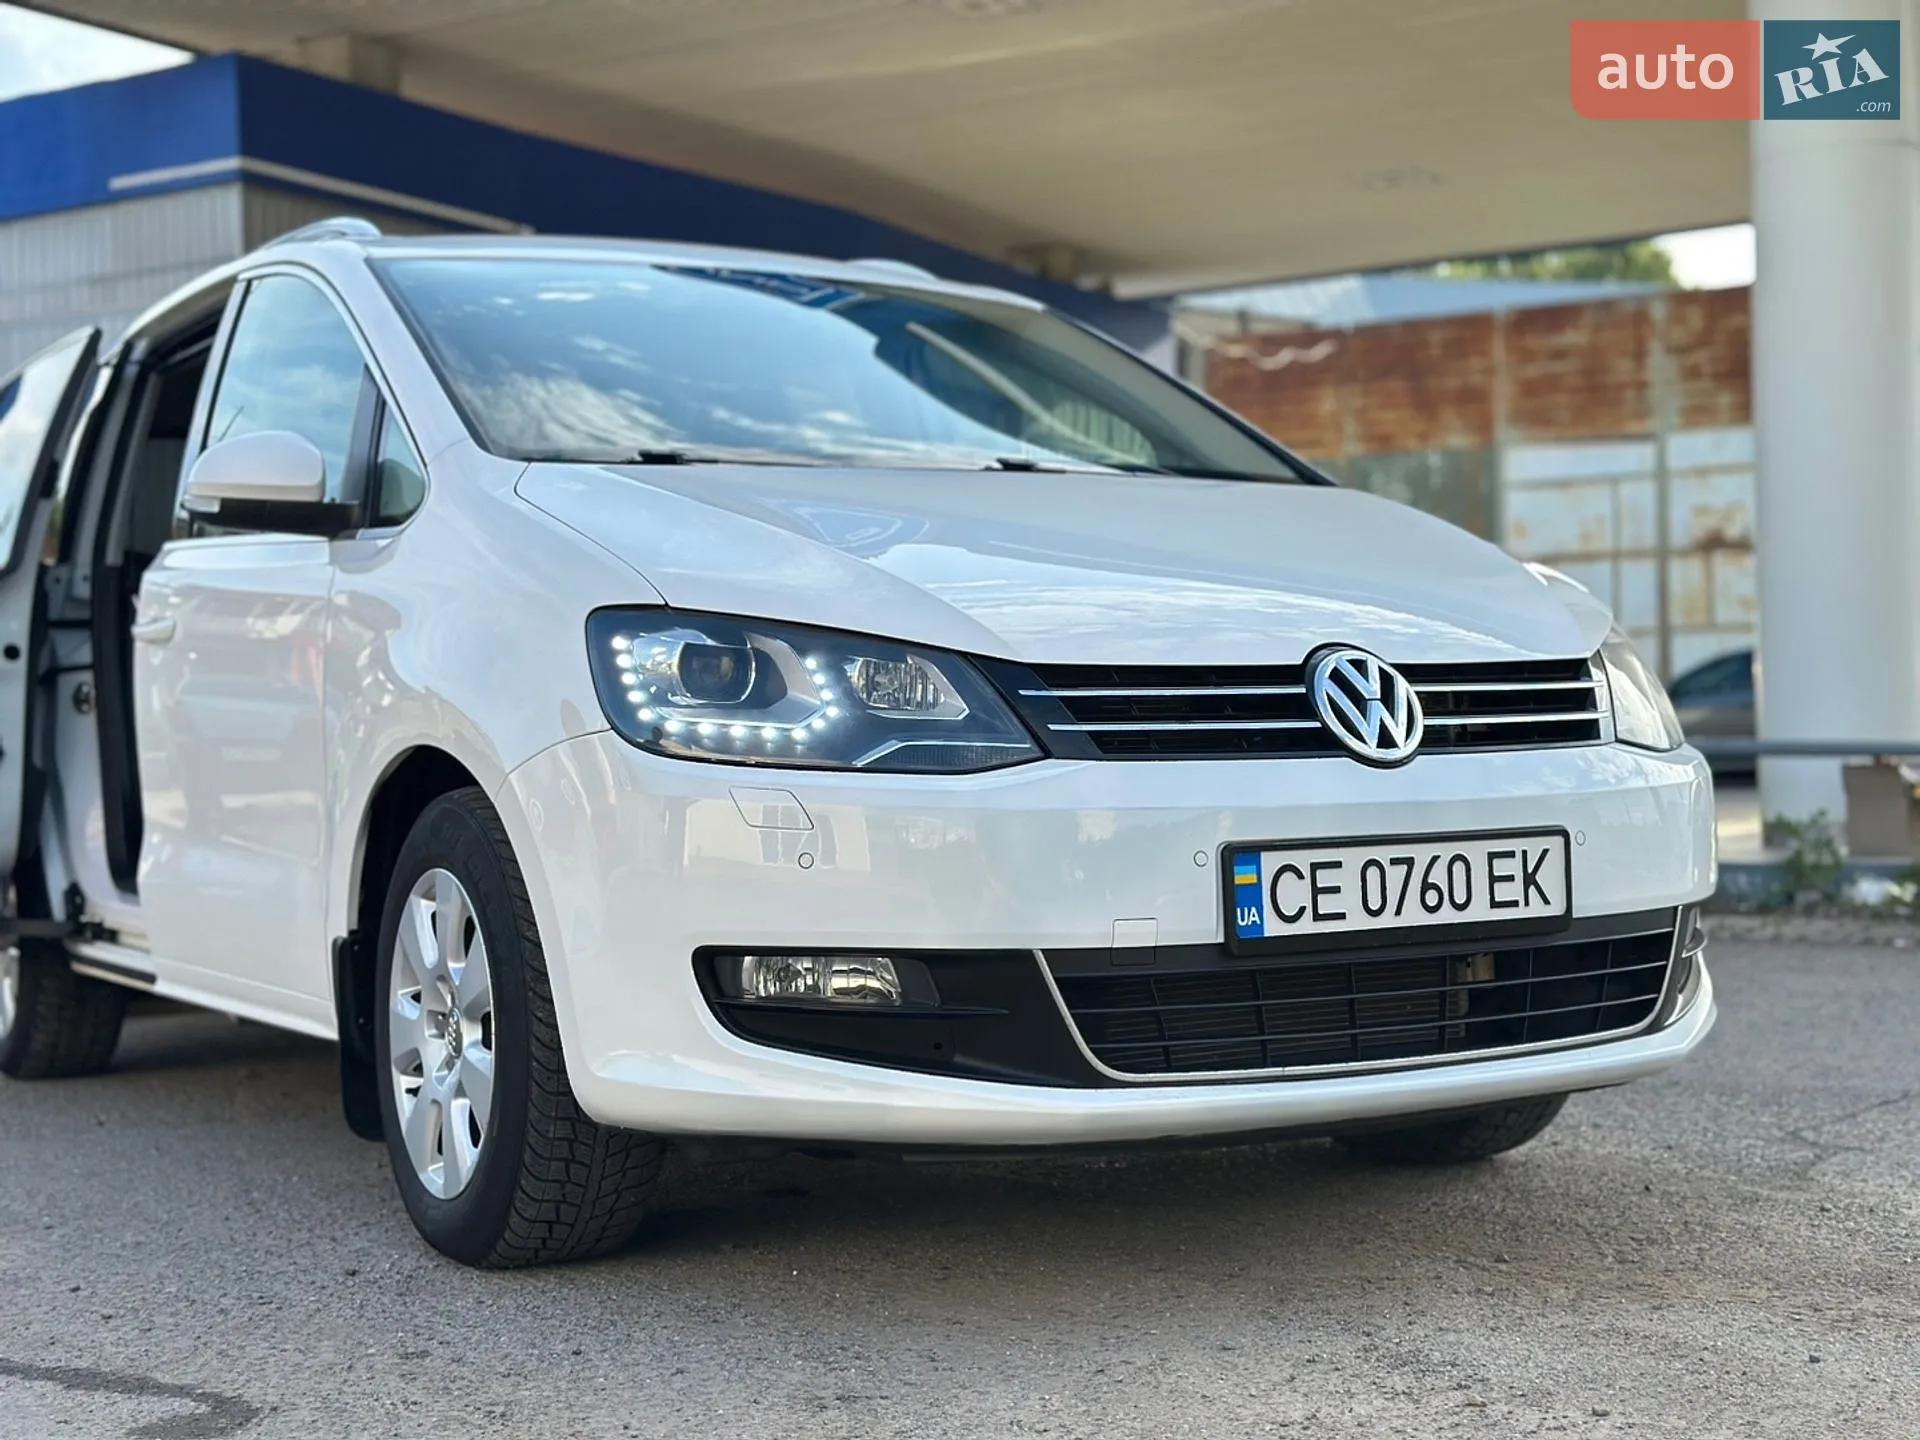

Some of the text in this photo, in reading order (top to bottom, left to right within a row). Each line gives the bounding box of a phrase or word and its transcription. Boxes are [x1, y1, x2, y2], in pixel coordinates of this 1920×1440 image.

[1269, 848, 1551, 924] CE 0760 EK
[1237, 906, 1260, 927] UA
